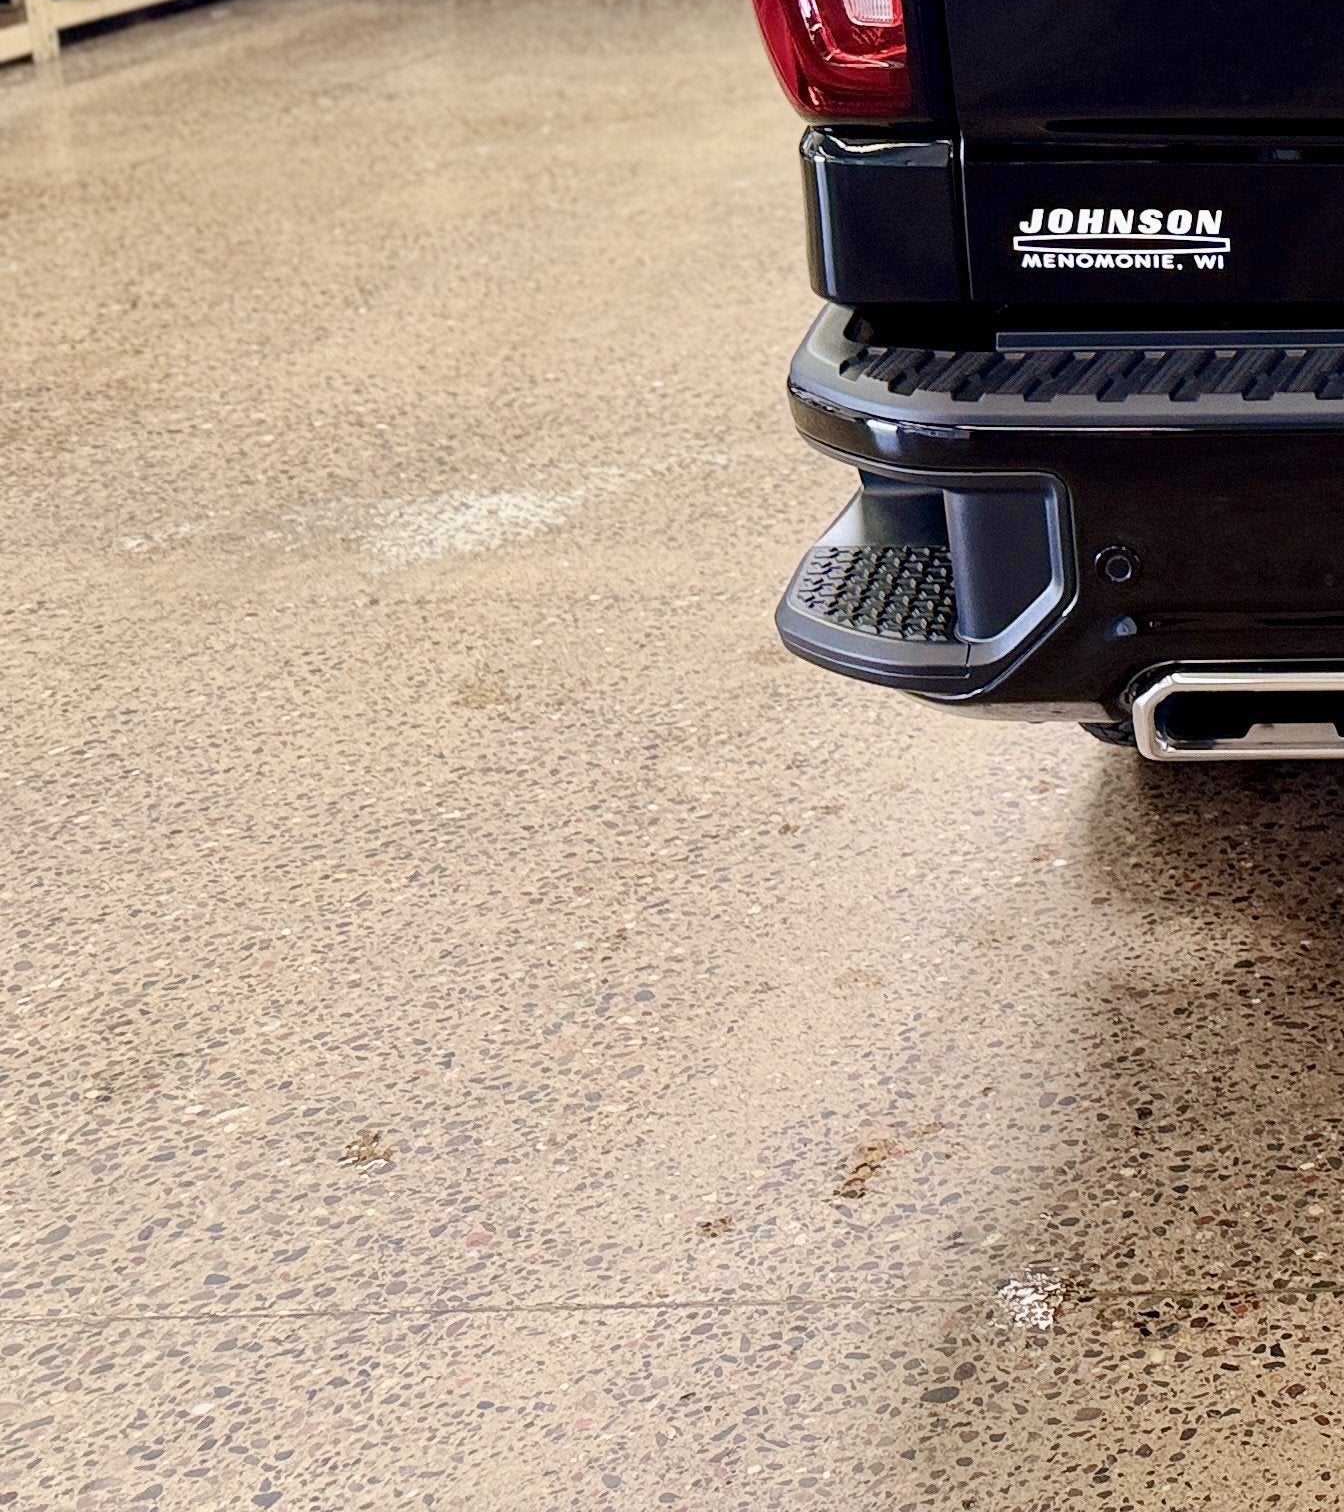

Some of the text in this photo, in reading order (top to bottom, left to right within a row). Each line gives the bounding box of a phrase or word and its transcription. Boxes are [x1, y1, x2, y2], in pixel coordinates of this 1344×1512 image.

[1018, 207, 1223, 235] JOHNSON
[1021, 253, 1225, 271] MENOMONIE, WI
